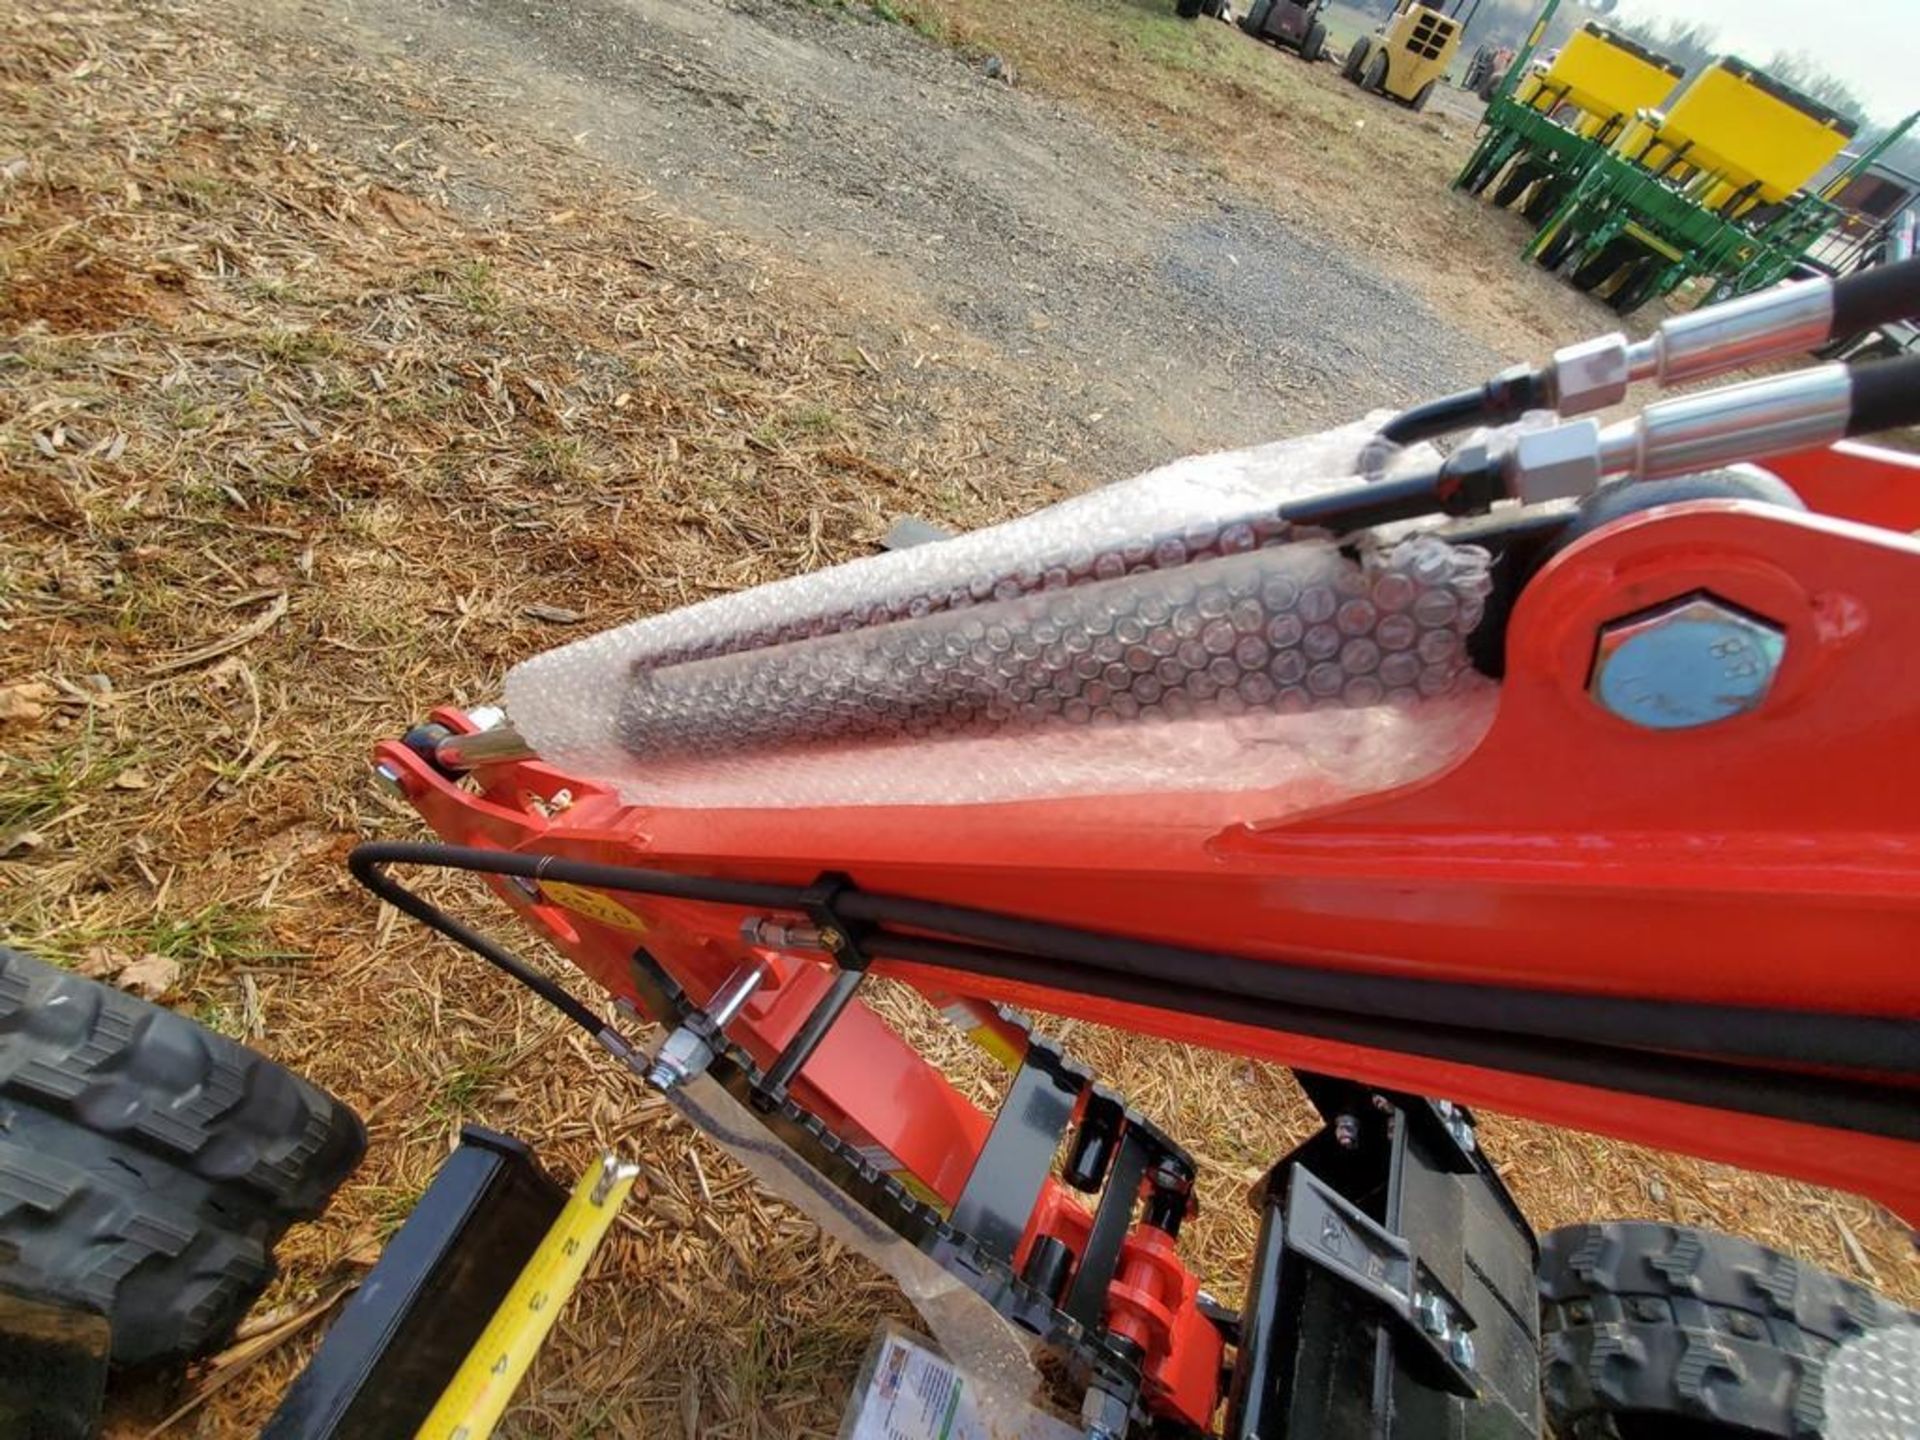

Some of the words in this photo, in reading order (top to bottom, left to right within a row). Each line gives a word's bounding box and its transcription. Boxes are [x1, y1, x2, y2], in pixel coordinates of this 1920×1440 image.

[562, 1237, 580, 1257] 2
[528, 1291, 549, 1312] 3
[491, 1353, 509, 1376] 4
